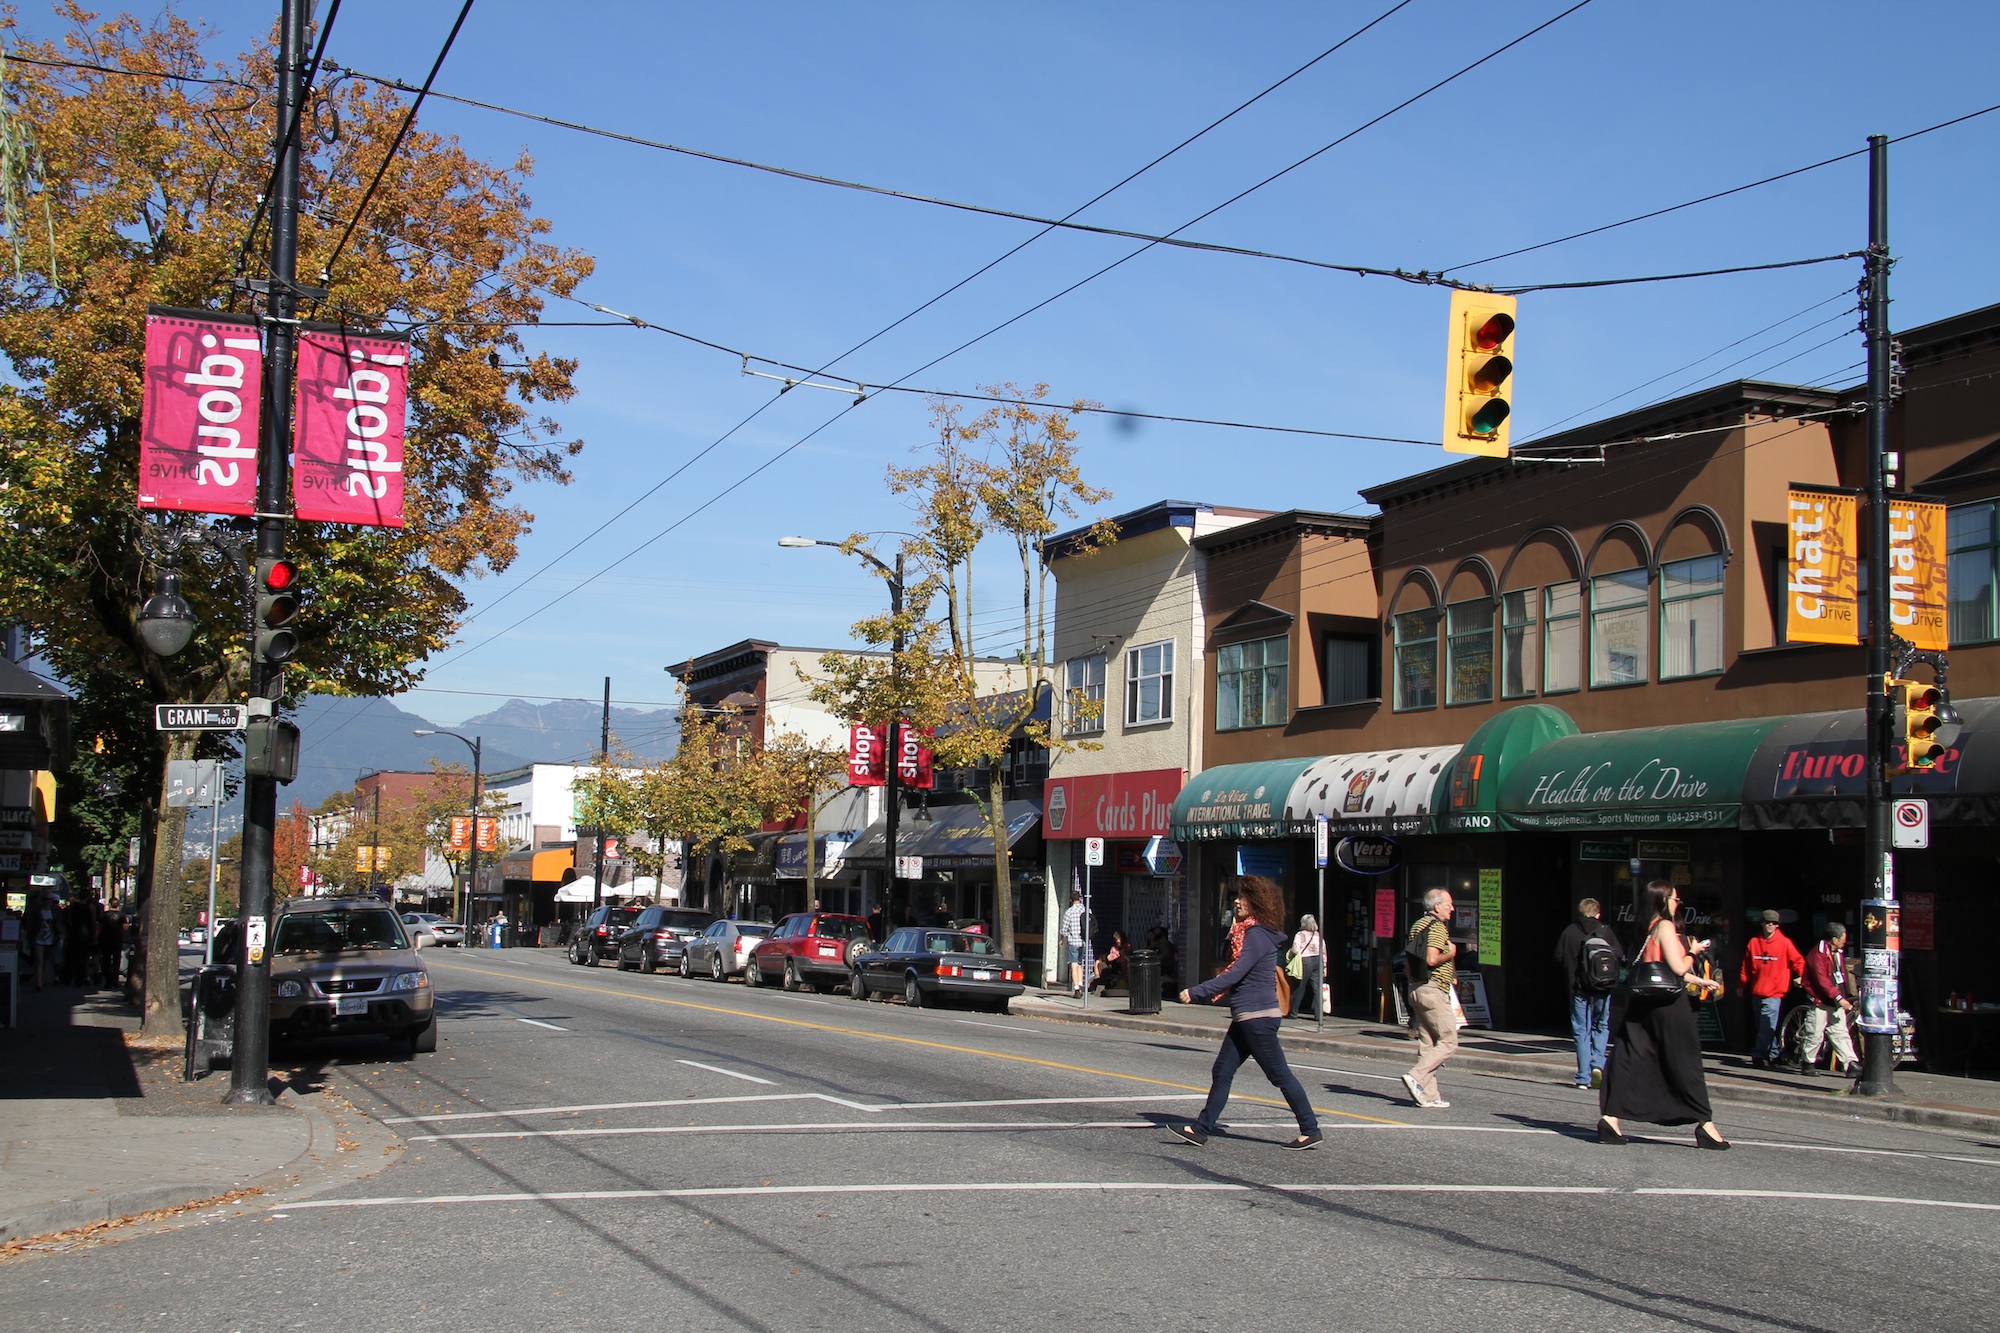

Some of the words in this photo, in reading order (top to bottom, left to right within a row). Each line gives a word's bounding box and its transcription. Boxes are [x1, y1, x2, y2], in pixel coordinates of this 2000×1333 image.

[1788, 499, 1825, 619] chat!
[1820, 604, 1851, 621] Drive
[1912, 612, 1943, 627] Drive
[1603, 619, 1639, 636] MEDICAL
[1608, 635, 1636, 650] OFFICE
[167, 708, 209, 726] GRANT
[218, 716, 237, 725] 1600
[222, 708, 231, 717] ST
[1782, 749, 1866, 781] Euro
[1527, 761, 1612, 805] Health
[1593, 785, 1616, 802] on
[1618, 758, 1660, 801] the
[1650, 766, 1709, 800] Drive
[1096, 791, 1136, 832] Cards
[1141, 788, 1174, 831] Plus
[1187, 804, 1241, 822] INTERNATIONAL
[1243, 802, 1272, 820] TRAVEL
[1598, 813, 1623, 825] Sports
[1624, 812, 1660, 823] Nutrition
[452, 818, 464, 847] dine!
[477, 819, 489, 848] dine!
[1354, 840, 1393, 858] Vera's
[1617, 903, 1636, 922] Hea
[1684, 906, 1712, 925] Drive
